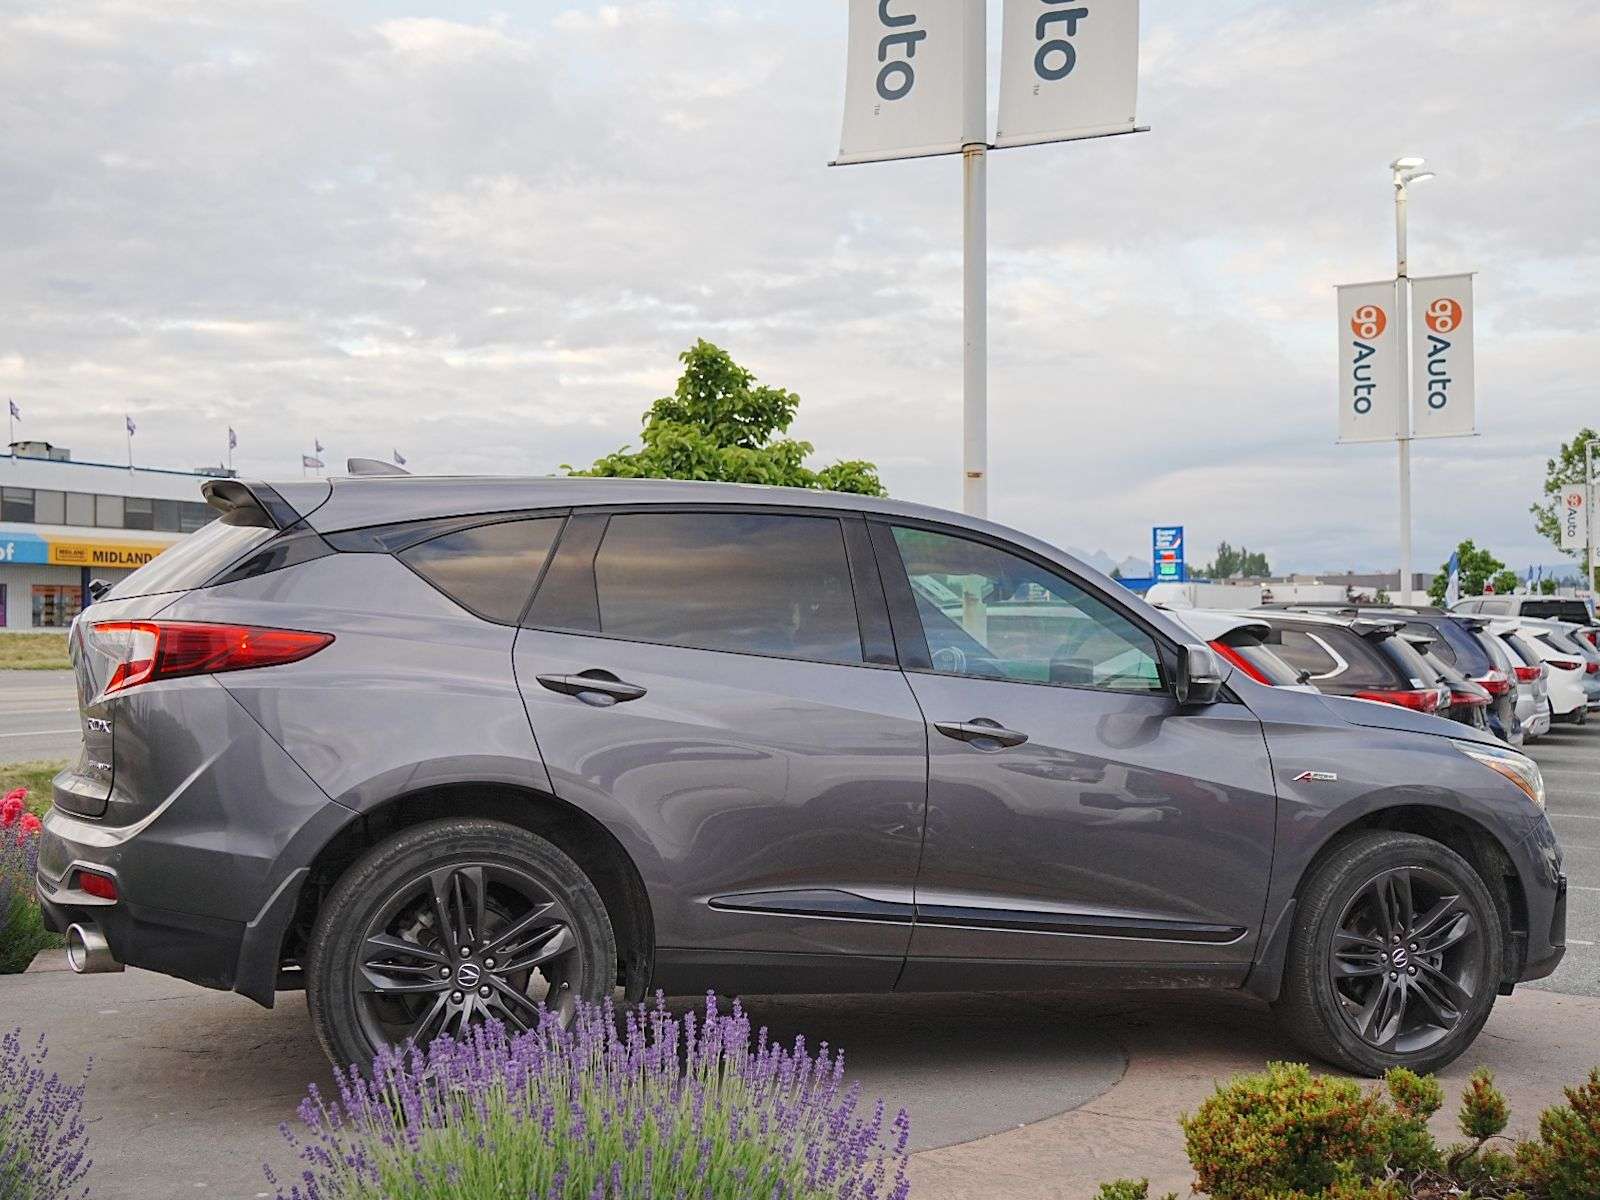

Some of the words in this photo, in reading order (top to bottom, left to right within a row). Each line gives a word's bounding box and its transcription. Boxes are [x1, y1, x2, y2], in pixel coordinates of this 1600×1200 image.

[876, 0, 927, 101] uto
[1034, 0, 1089, 81] to
[1352, 341, 1376, 414] Auto
[1427, 335, 1452, 409] Auto
[93, 551, 152, 564] MIDLAND
[1567, 507, 1577, 538] Auto
